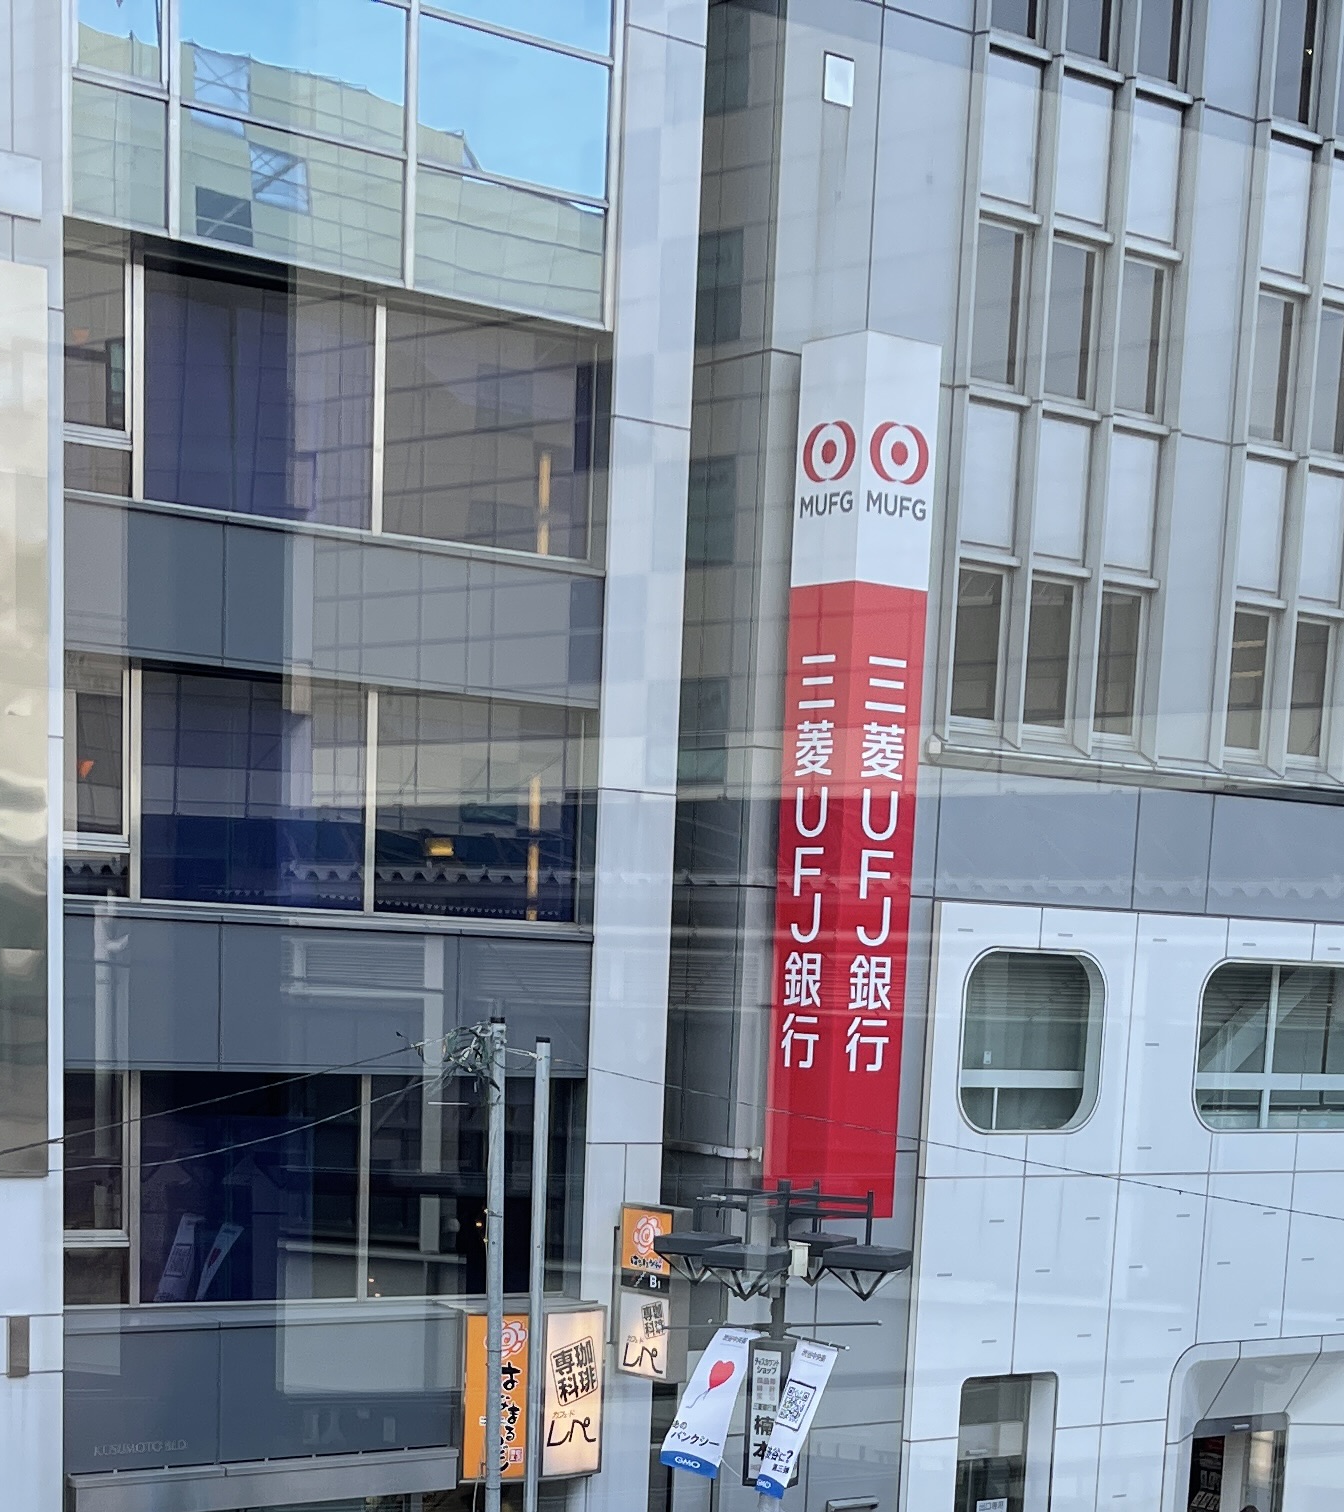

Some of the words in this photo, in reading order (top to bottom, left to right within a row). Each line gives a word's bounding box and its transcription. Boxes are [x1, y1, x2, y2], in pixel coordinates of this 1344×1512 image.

[799, 489, 854, 519] MUFG
[866, 489, 927, 521] MUFG
[780, 654, 837, 1069] 三菱UFJ銀行
[844, 655, 908, 1073] 三菱UFJ銀行
[649, 1274, 661, 1289] B1
[670, 1431, 719, 1447] バンクシー
[674, 1456, 701, 1469] GMO
